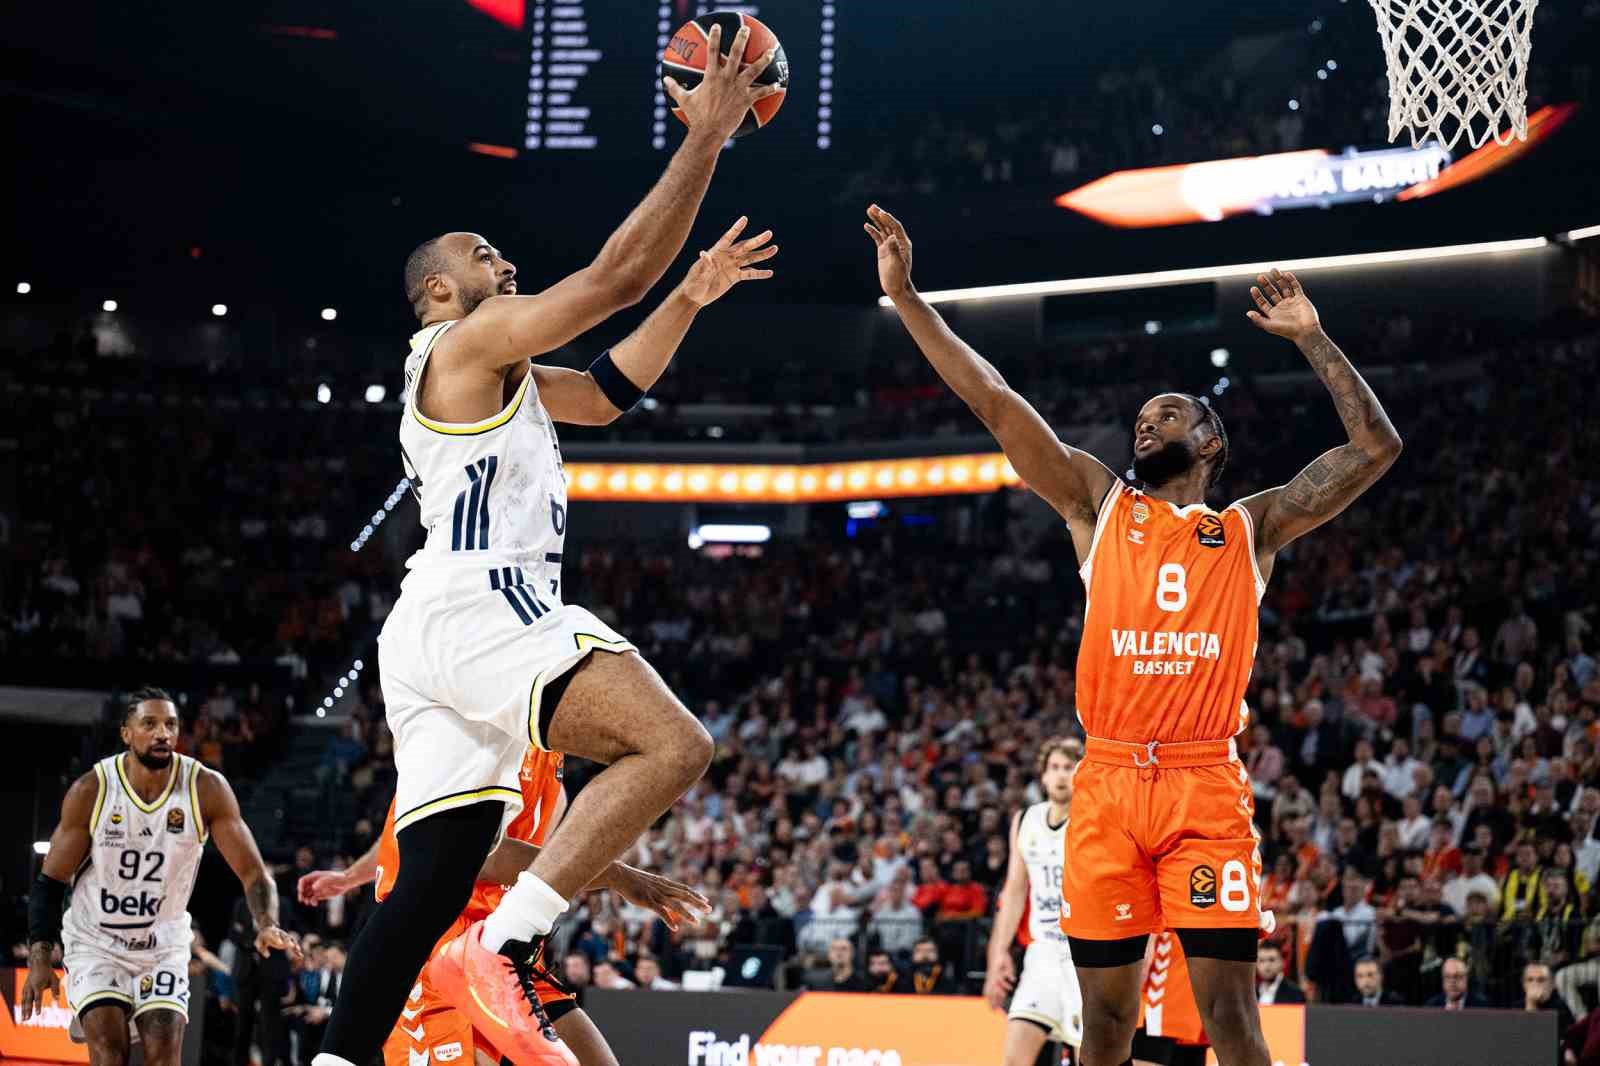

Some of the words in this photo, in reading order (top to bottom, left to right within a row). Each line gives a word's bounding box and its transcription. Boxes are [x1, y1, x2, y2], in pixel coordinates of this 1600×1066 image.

[1156, 563, 1187, 613] 8
[1111, 629, 1220, 660] VALENCIA
[1132, 660, 1195, 675] BASKET
[118, 850, 165, 882] 92
[1220, 860, 1250, 912] 8
[688, 1031, 749, 1066] Find
